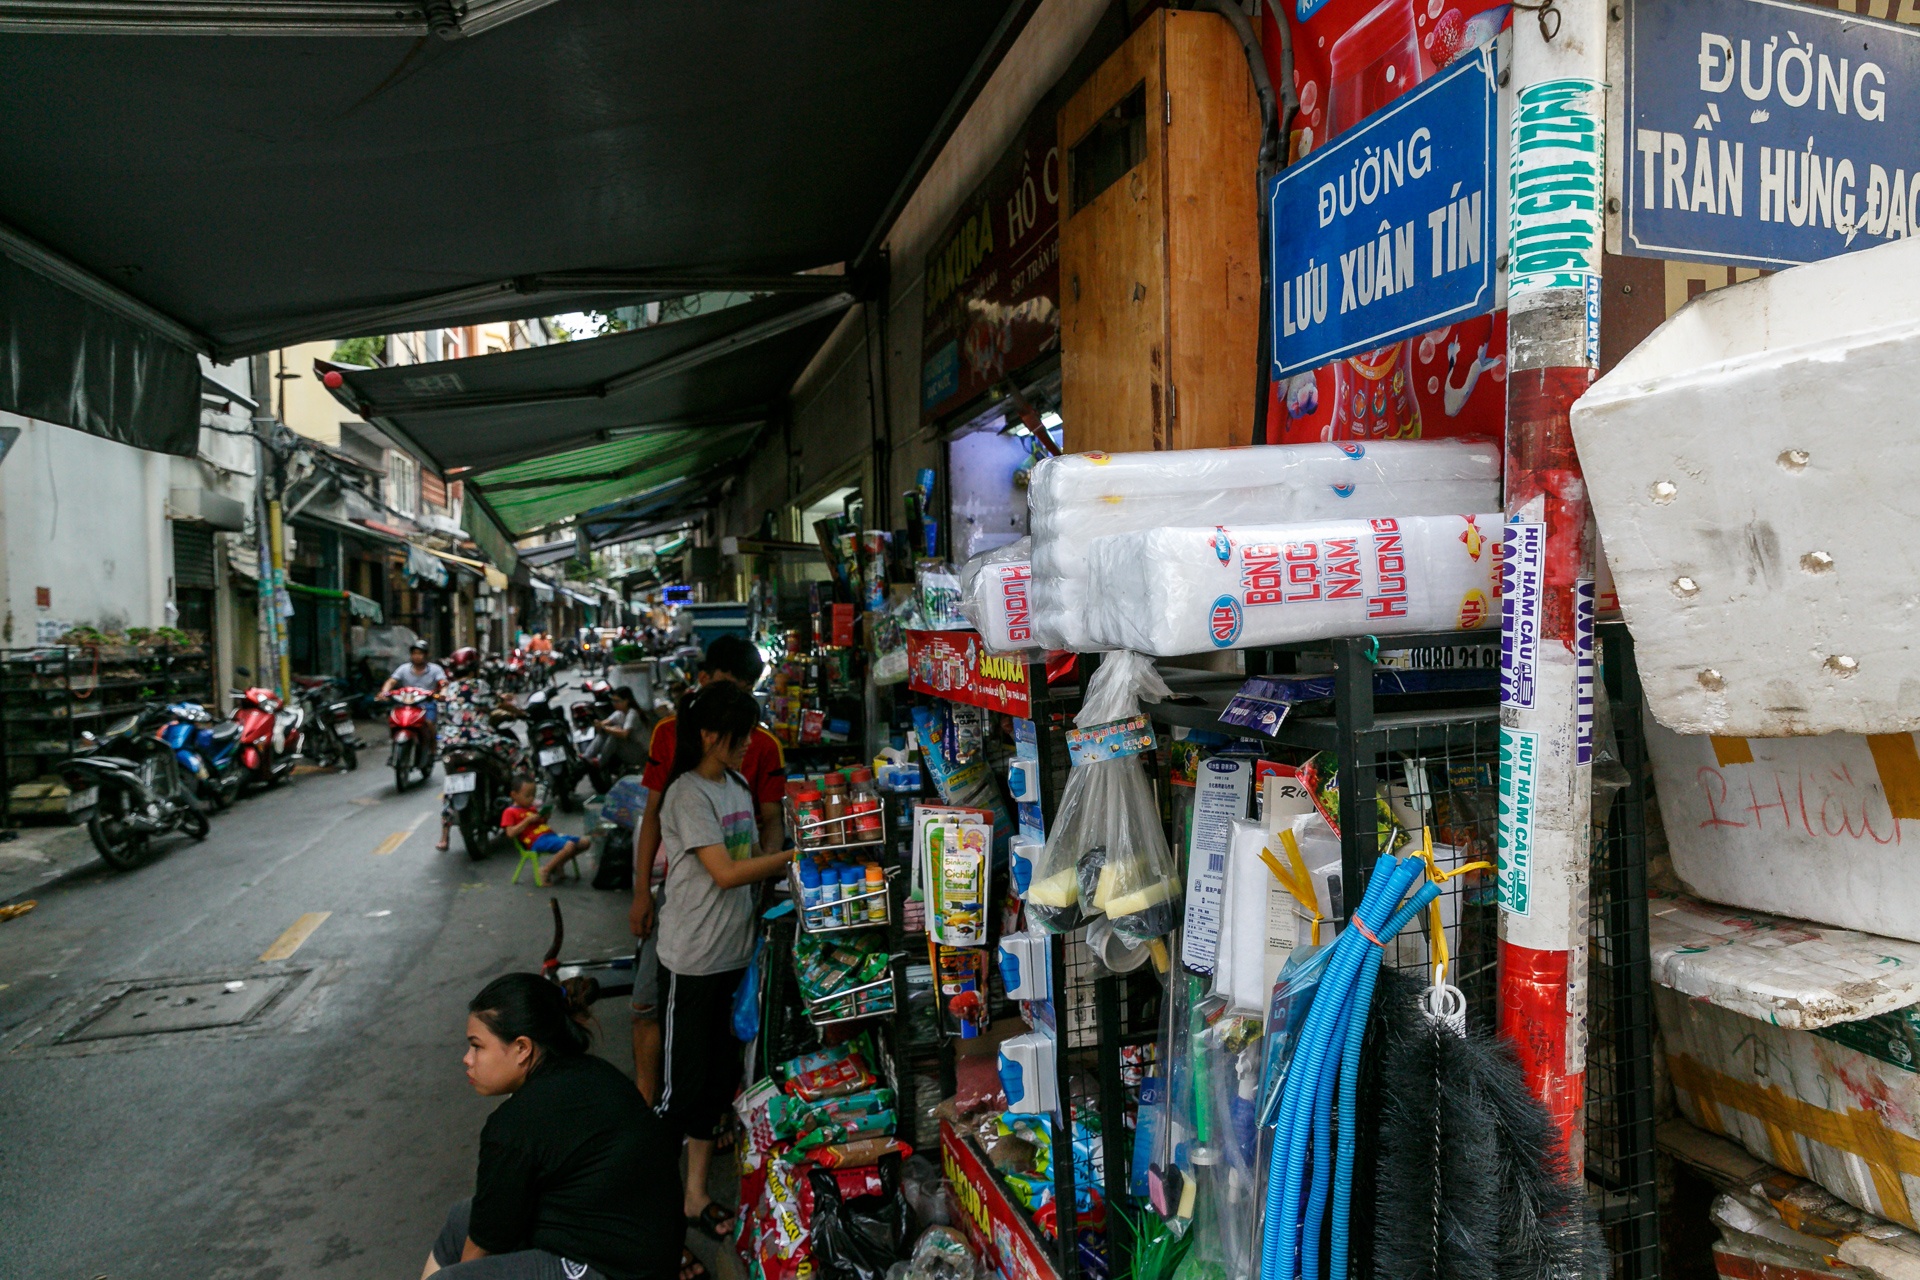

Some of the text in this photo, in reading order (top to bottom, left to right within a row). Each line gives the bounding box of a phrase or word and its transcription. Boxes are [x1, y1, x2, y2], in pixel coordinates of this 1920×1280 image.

[1698, 31, 1886, 122] ĐƯỜNG
[1318, 127, 1432, 229] ĐƯỜNG
[1637, 103, 1744, 217] TRẦN
[1340, 219, 1415, 315] XUÂN
[1428, 181, 1482, 279] TÍN
[1242, 544, 1282, 606] BÔNG
[1286, 542, 1321, 602] LỌC
[1325, 537, 1362, 600] NĂM
[1367, 517, 1408, 620] HƯƠNG
[1519, 527, 1540, 660] HÚT HẦM CẦU
[979, 648, 1025, 684] SAKURA
[1513, 736, 1535, 867] HÚT HẦM CẦU
[945, 858, 971, 868] Sinking
[945, 868, 976, 879] Cichlid
